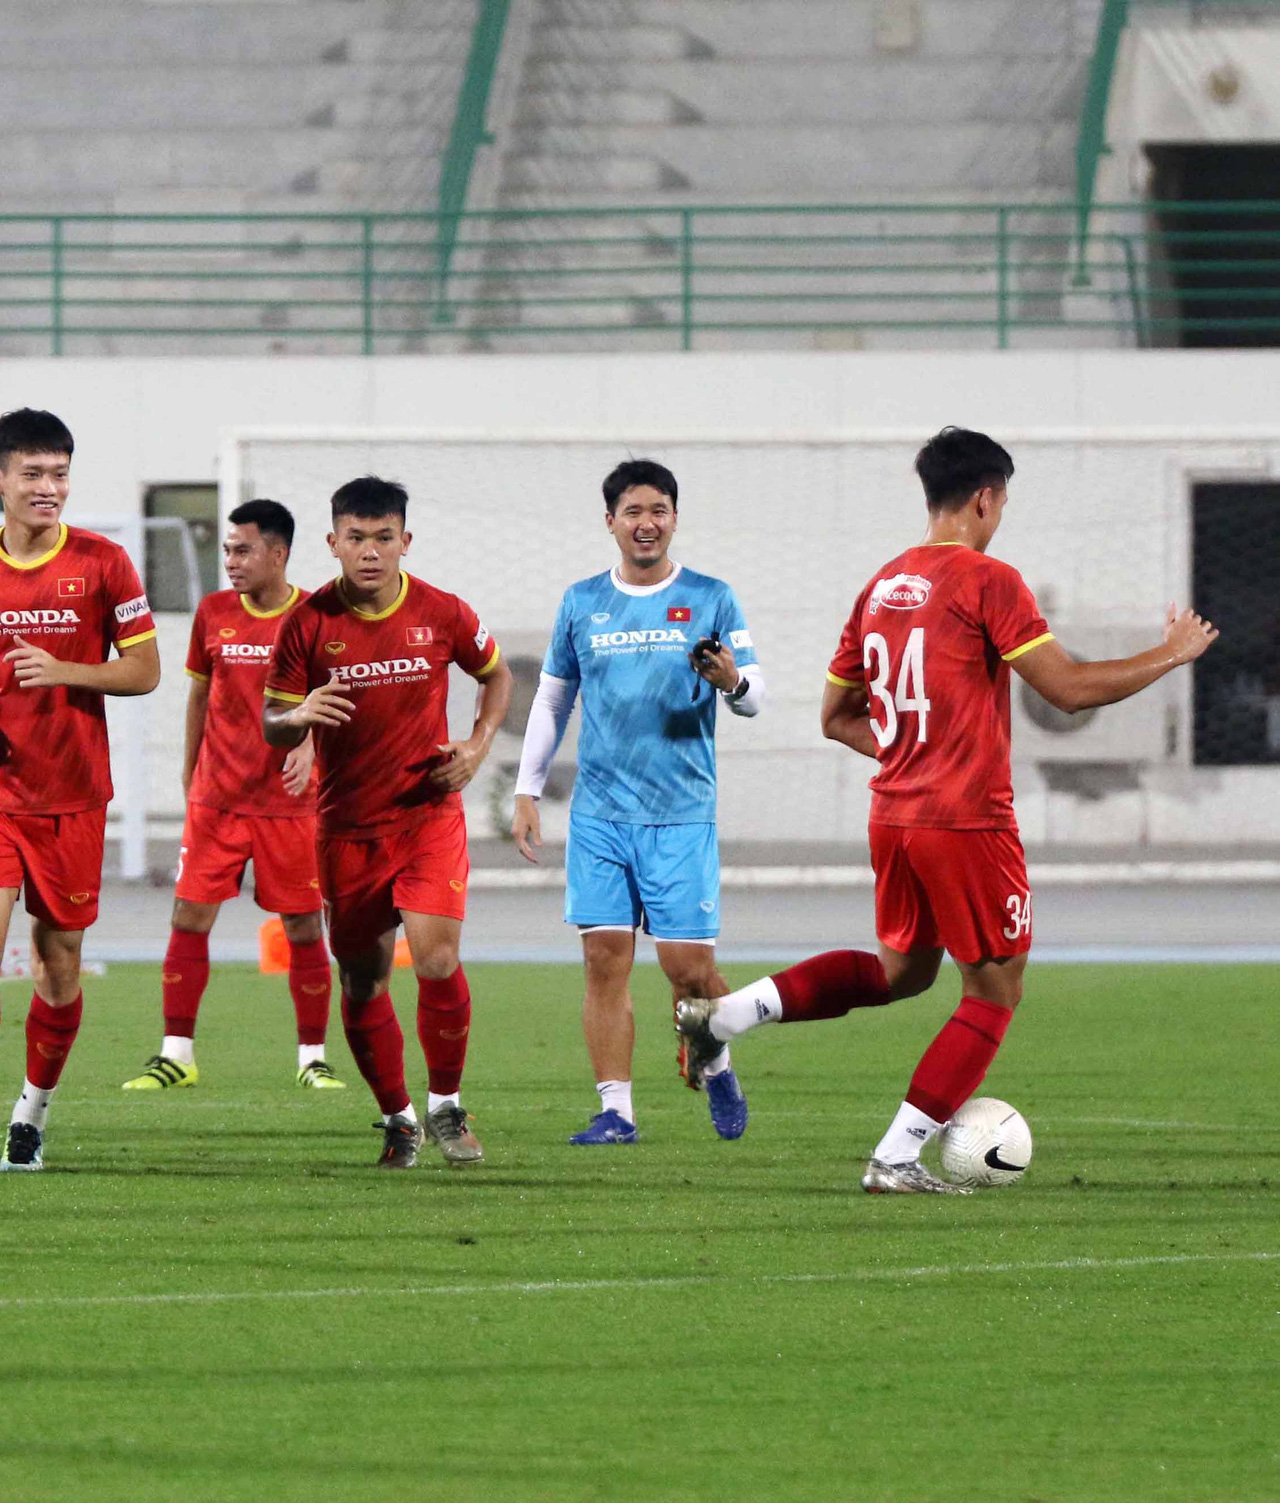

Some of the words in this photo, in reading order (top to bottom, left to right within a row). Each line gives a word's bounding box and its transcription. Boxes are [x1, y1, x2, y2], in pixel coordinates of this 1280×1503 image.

[3, 627, 30, 635] Power
[32, 626, 41, 634] of
[590, 629, 688, 648] HONDA
[221, 644, 274, 657] HON
[594, 649, 609, 657] The
[611, 646, 637, 655] Power
[639, 644, 648, 652] of
[650, 644, 685, 652] Dreams
[328, 657, 432, 680] HONDA
[352, 679, 381, 688] Power
[383, 676, 393, 685] of
[395, 673, 428, 682] Dreams
[863, 628, 931, 748] 34
[1004, 891, 1031, 940] 34
